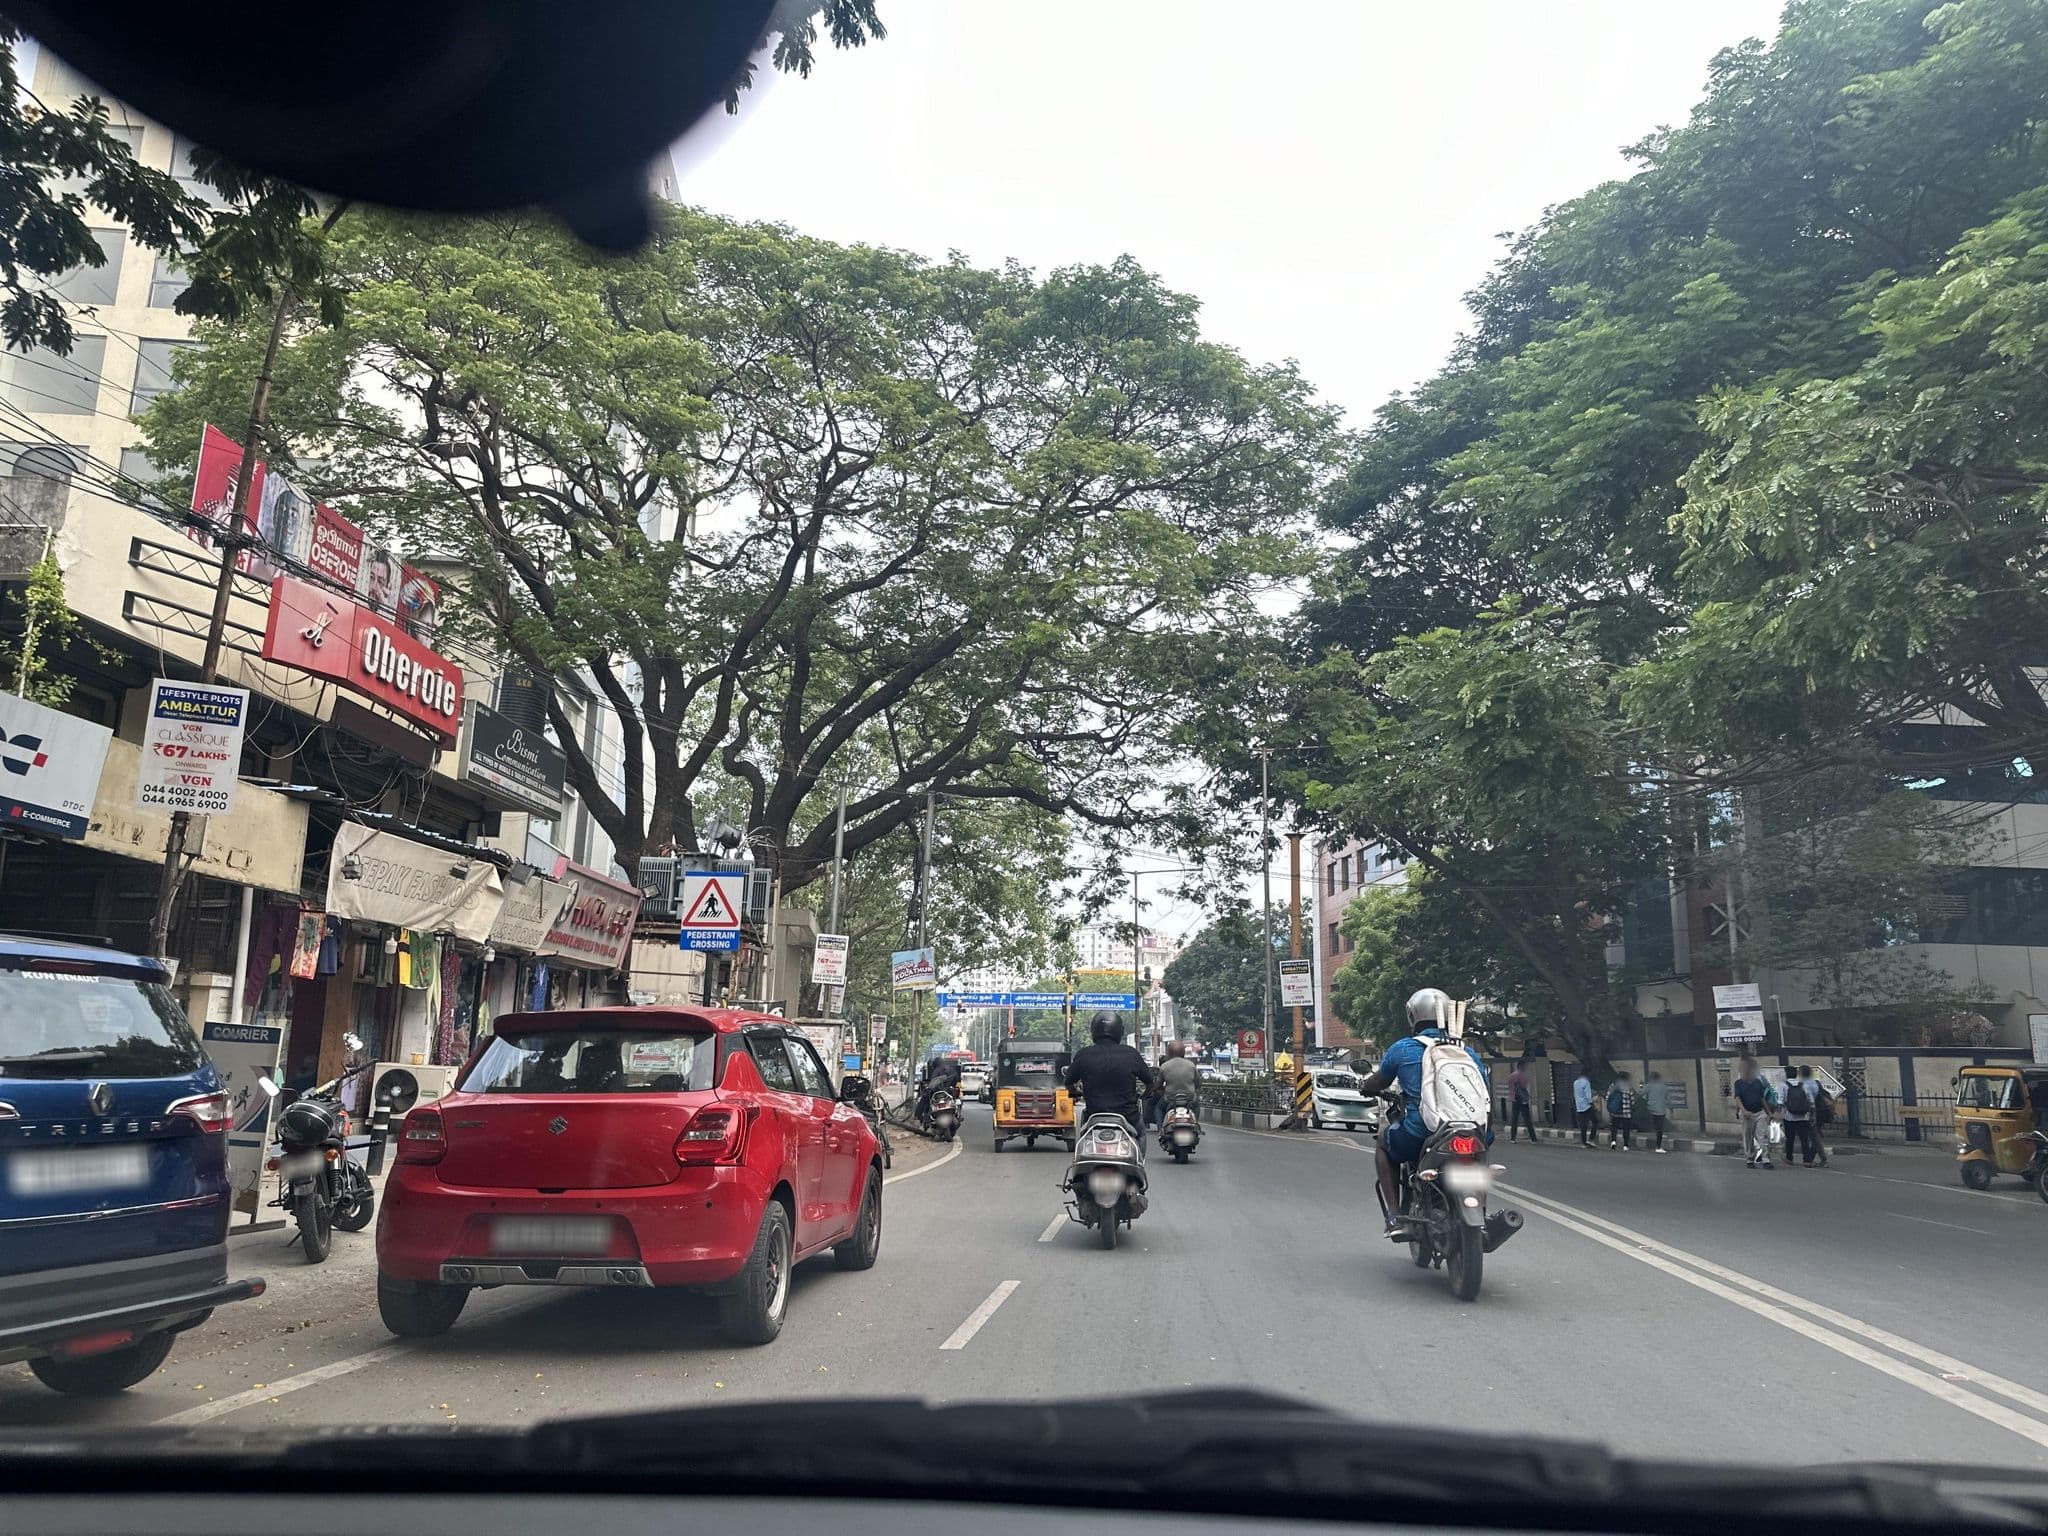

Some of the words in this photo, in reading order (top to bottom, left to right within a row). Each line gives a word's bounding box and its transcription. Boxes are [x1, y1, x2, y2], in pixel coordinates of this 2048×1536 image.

[311, 542, 358, 585] OBEROIE
[364, 626, 456, 716] Oberoie
[159, 688, 209, 701] LIFESTYLE
[210, 694, 241, 705] PLOTS
[158, 700, 238, 718] AMBATTUR
[182, 724, 203, 732] VGN
[158, 729, 230, 747] CLASSIQUE
[507, 729, 540, 763] Bismi
[175, 761, 208, 770] ONWARDS
[495, 744, 546, 782] Communication
[181, 774, 213, 787] VGN
[143, 784, 165, 794] 044
[168, 787, 196, 797] 4002
[198, 790, 228, 800] 4000
[62, 800, 85, 812] DTDC
[142, 794, 165, 804] 044
[167, 796, 195, 807] 6965
[197, 800, 227, 810] 6900
[22, 810, 72, 828] E-COMMERCE
[686, 931, 736, 939] PEDESTRAIN
[690, 940, 731, 948] CROSSING
[21, 971, 55, 981] KUN
[57, 974, 100, 983] RENAULT
[212, 1026, 270, 1041] COURIER
[1445, 1079, 1476, 1113] SOLINCO
[20, 1121, 161, 1137] TRIBER
